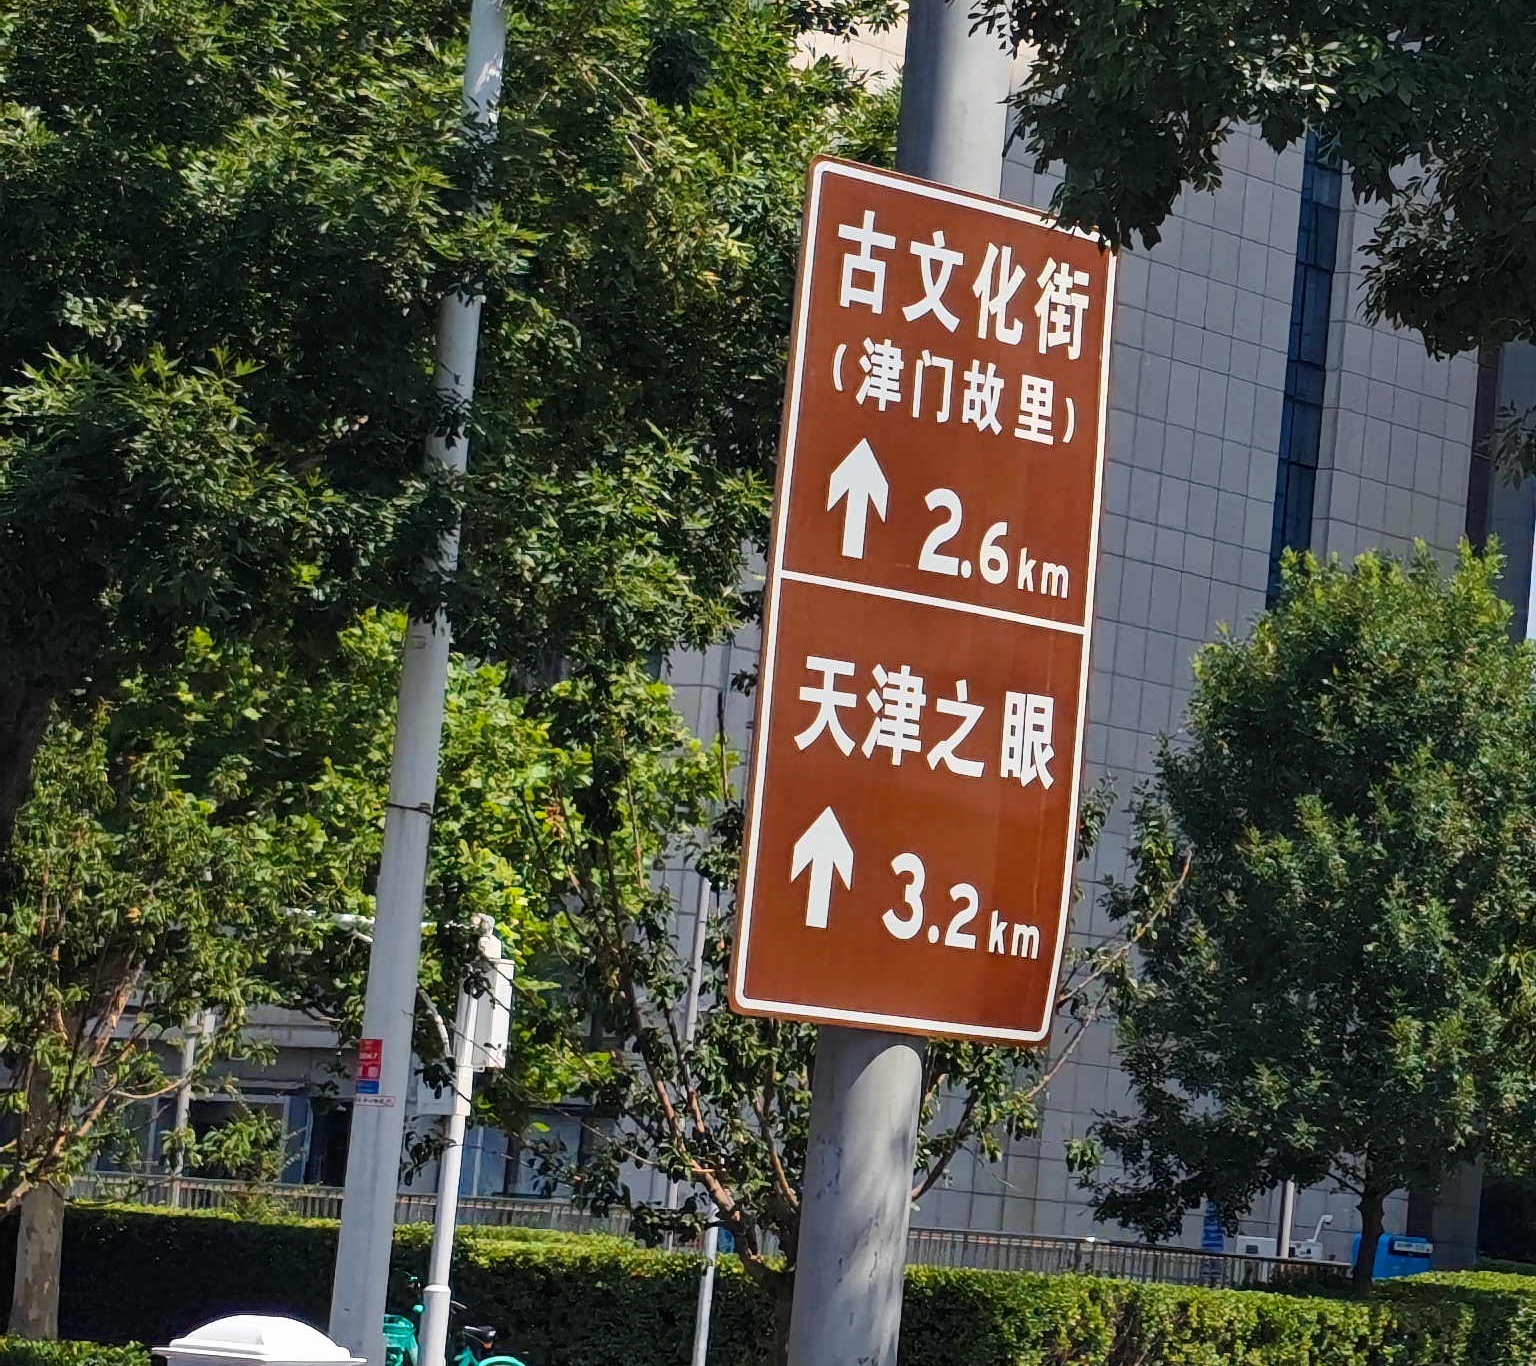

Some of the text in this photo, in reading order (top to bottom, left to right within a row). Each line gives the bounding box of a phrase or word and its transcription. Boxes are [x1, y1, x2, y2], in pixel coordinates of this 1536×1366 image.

[837, 210, 1091, 361] 古文化街
[793, 655, 1056, 790] 天津之眼
